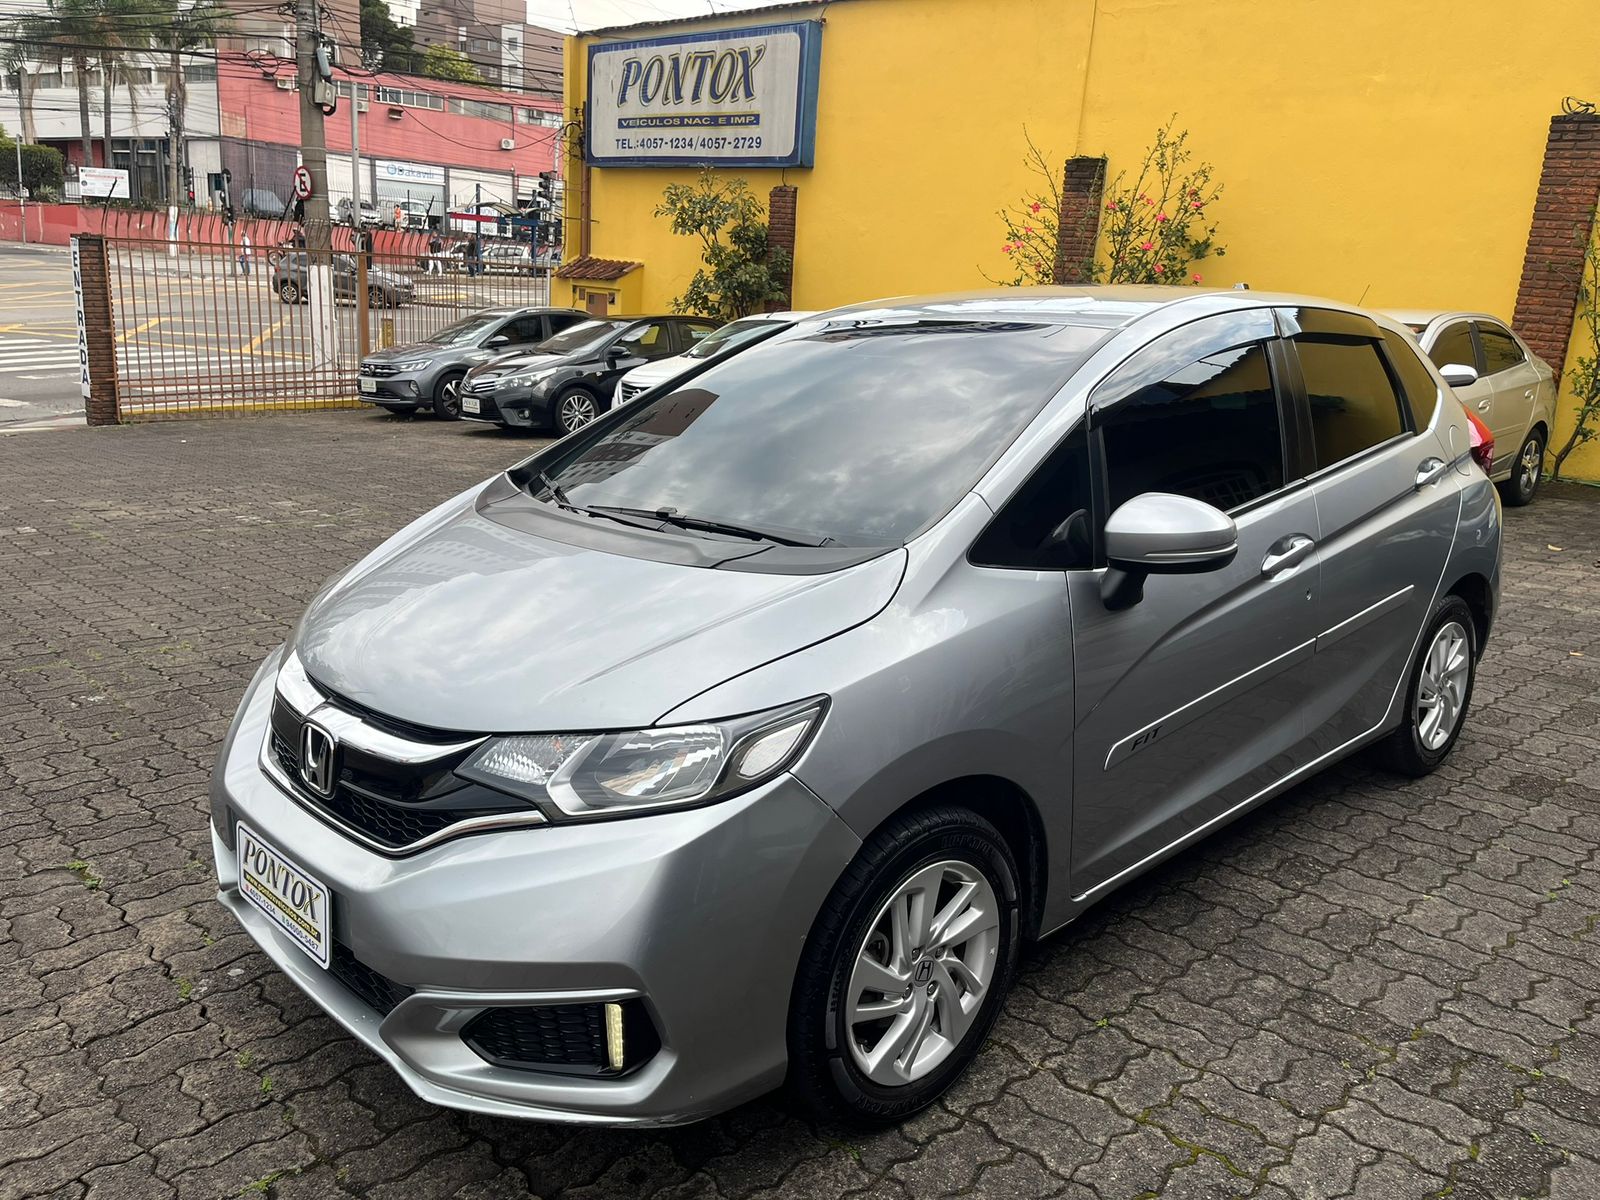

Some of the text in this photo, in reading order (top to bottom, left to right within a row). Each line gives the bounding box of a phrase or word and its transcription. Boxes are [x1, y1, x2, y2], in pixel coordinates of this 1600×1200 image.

[617, 45, 766, 108] PONTOX
[684, 117, 714, 125] NAC.
[718, 116, 726, 124] E
[730, 116, 757, 124] IMP.
[72, 251, 89, 385] ENTRADA
[1131, 725, 1162, 751] FIT
[243, 836, 320, 924] PONTOX
